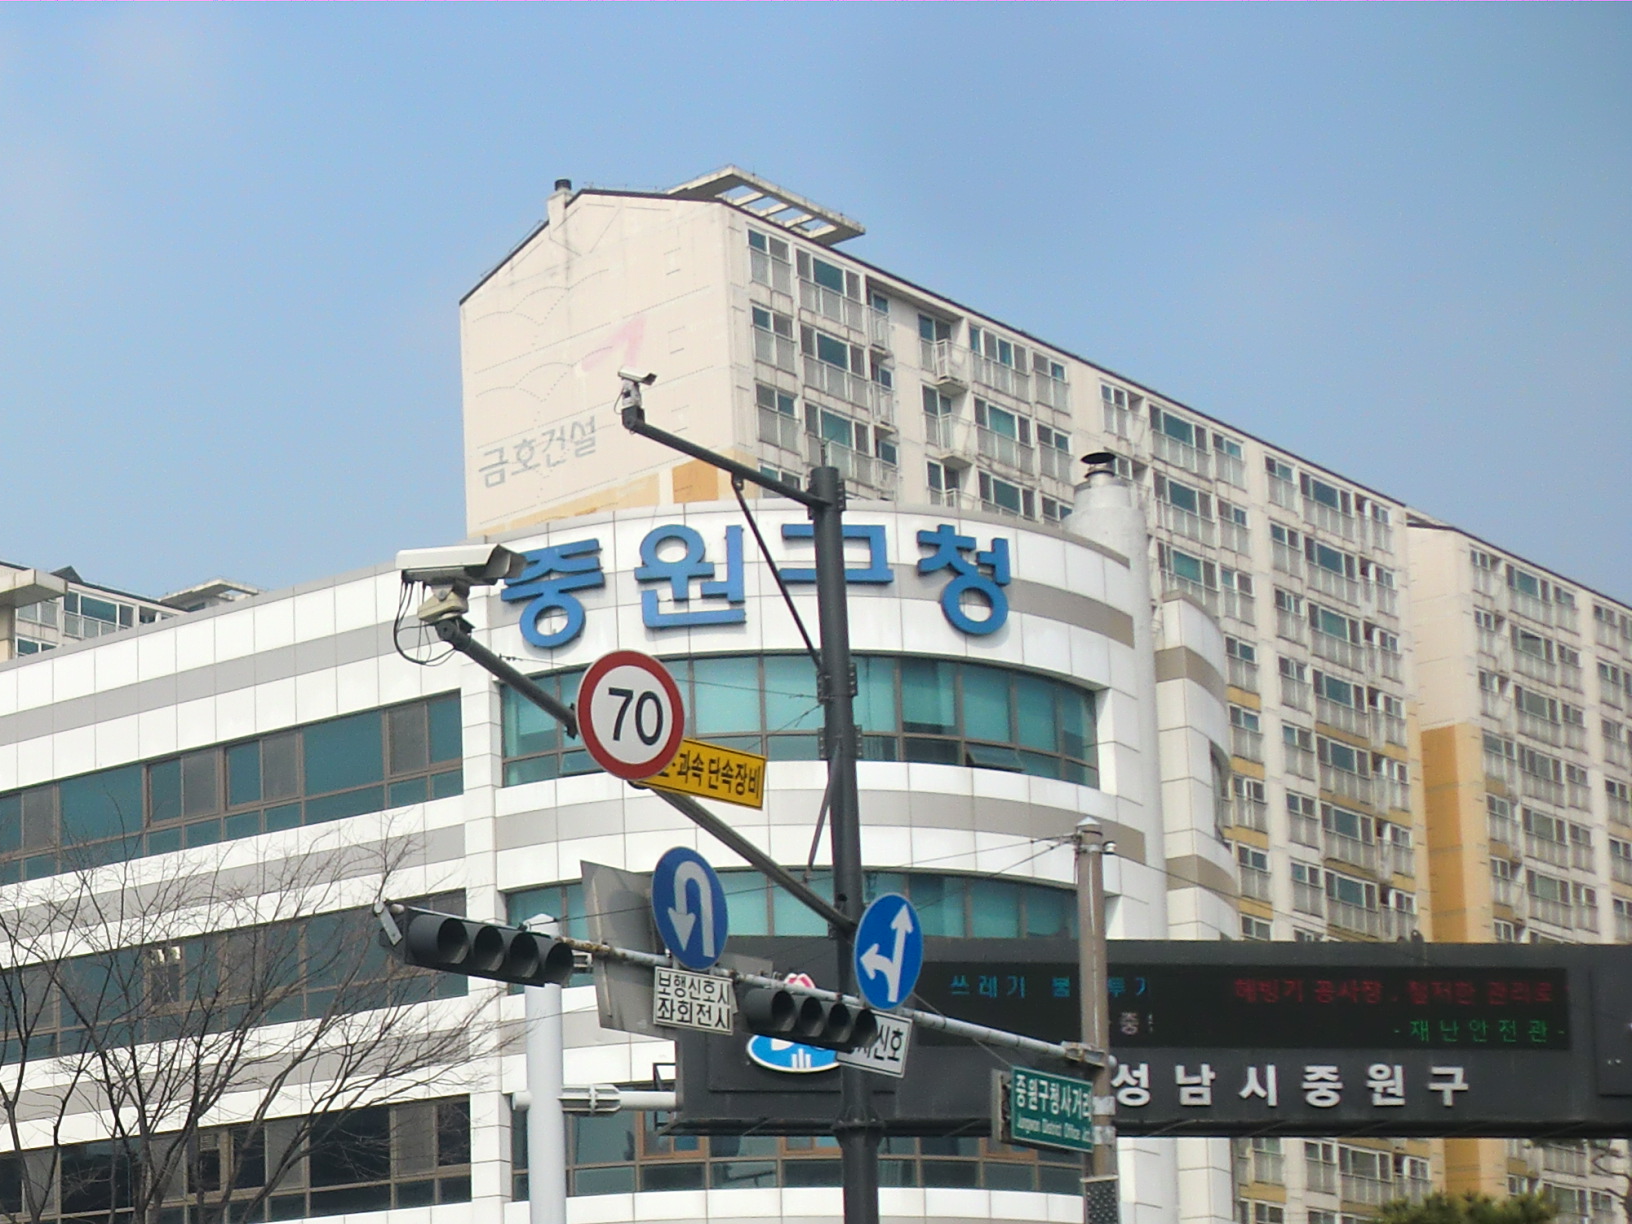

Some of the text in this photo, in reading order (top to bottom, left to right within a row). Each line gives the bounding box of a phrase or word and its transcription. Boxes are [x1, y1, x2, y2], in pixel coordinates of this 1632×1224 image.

[478, 415, 598, 488] 금호건설
[500, 523, 1011, 649] 중원구청
[608, 687, 663, 747] 70
[709, 757, 761, 799] 단속장비
[657, 997, 730, 1030] 좌회전시
[658, 970, 730, 1006] 보행신호시
